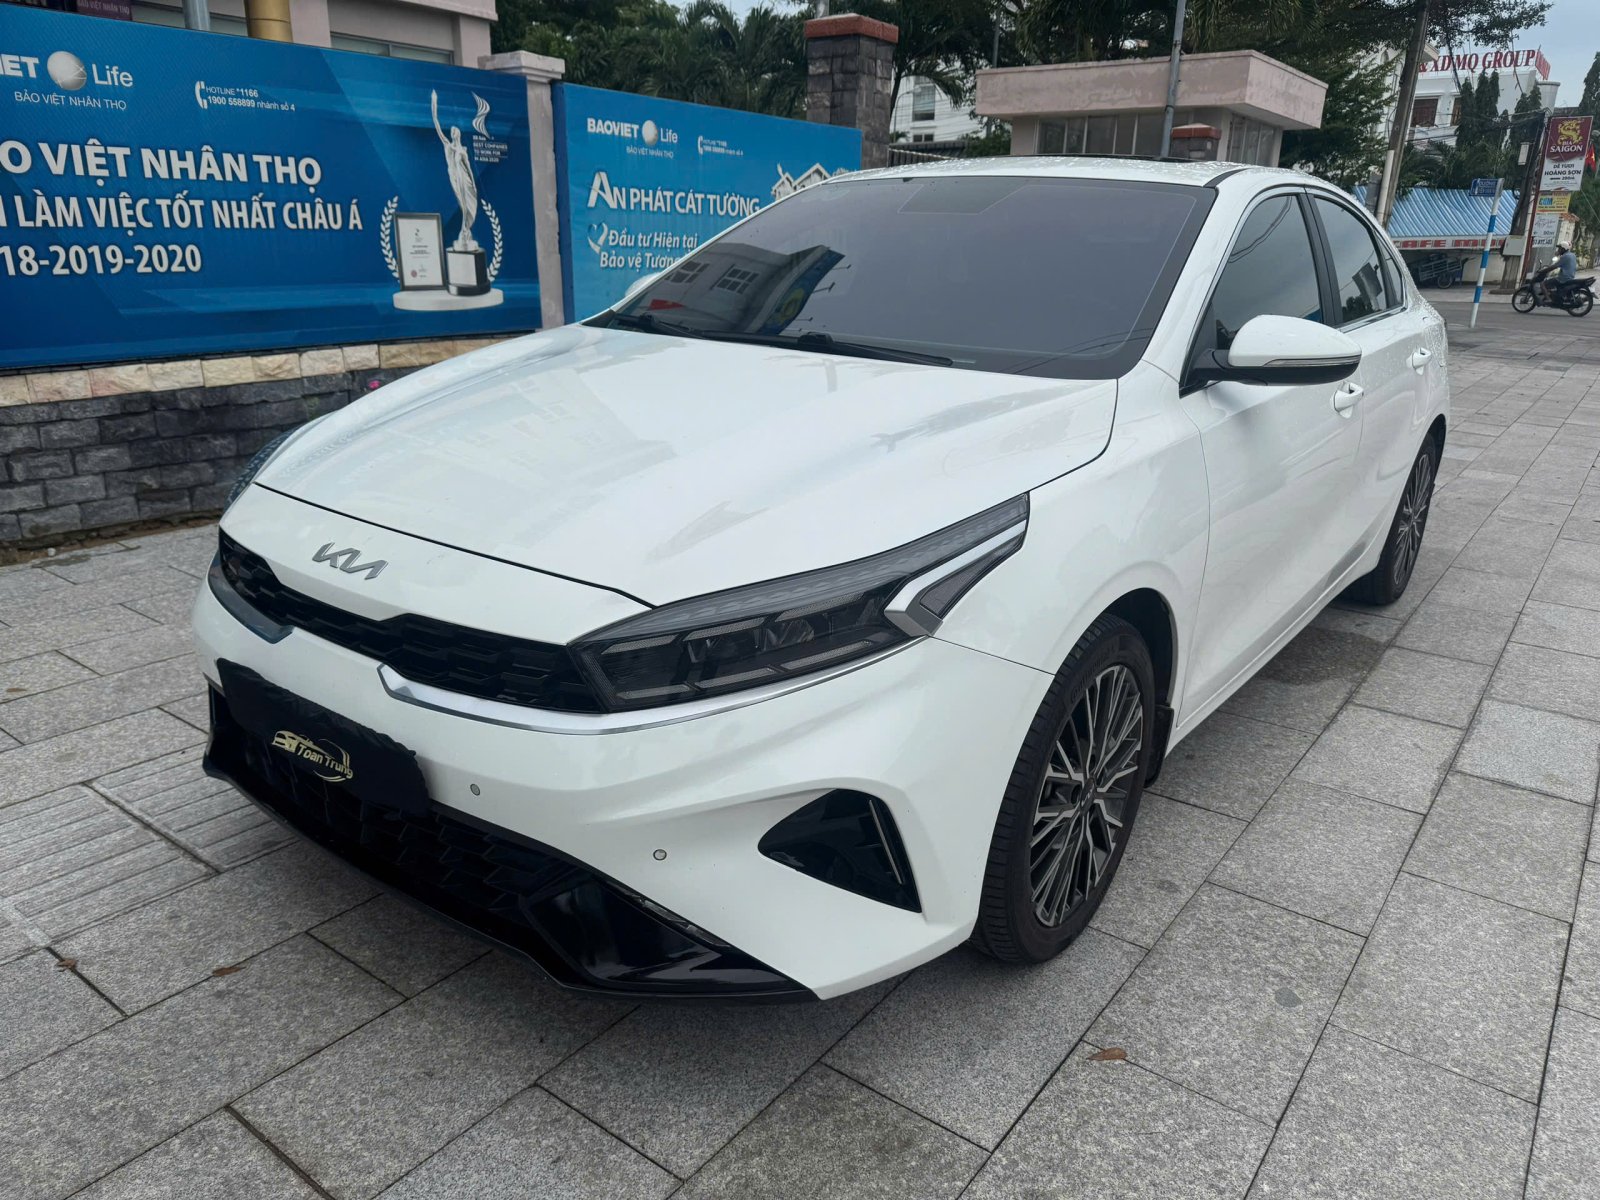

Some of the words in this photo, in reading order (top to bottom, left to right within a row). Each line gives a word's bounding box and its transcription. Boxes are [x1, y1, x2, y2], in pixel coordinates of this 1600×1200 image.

[1481, 49, 1536, 70] GROUP
[91, 63, 134, 88] Life
[14, 88, 40, 103] BẢO
[42, 92, 66, 107] VIỆT
[69, 94, 102, 109] NHÂN
[103, 98, 127, 111] THỌ
[205, 86, 235, 96] HOTLINE
[207, 95, 226, 106] 1900
[228, 97, 255, 108] 558899
[290, 103, 295, 112] 4
[587, 117, 639, 139] BAOVIET
[660, 127, 678, 144] Life
[1550, 145, 1583, 153] SAIGON
[38, 138, 131, 187] VIỆT
[140, 145, 248, 182] NHÂN
[252, 156, 322, 194] THỌ
[587, 171, 626, 210] AN
[630, 186, 674, 213] PHÁT
[674, 189, 705, 214] CÁT
[706, 192, 760, 217] TƯỜNG
[13, 188, 84, 228] LÀM
[86, 191, 153, 237] VIỆC
[155, 189, 204, 229] TỐT
[211, 192, 276, 229] NHẤT
[282, 197, 343, 231] CHÂU
[348, 198, 363, 230] Á
[637, 232, 652, 248] tư
[653, 231, 680, 252] Hiện
[682, 232, 698, 252] tại
[0, 244, 202, 277] 18-2019-2020
[600, 250, 625, 268] Bảo
[627, 251, 642, 273] vệ
[312, 542, 389, 580] KIA
[324, 755, 354, 779] Trung
